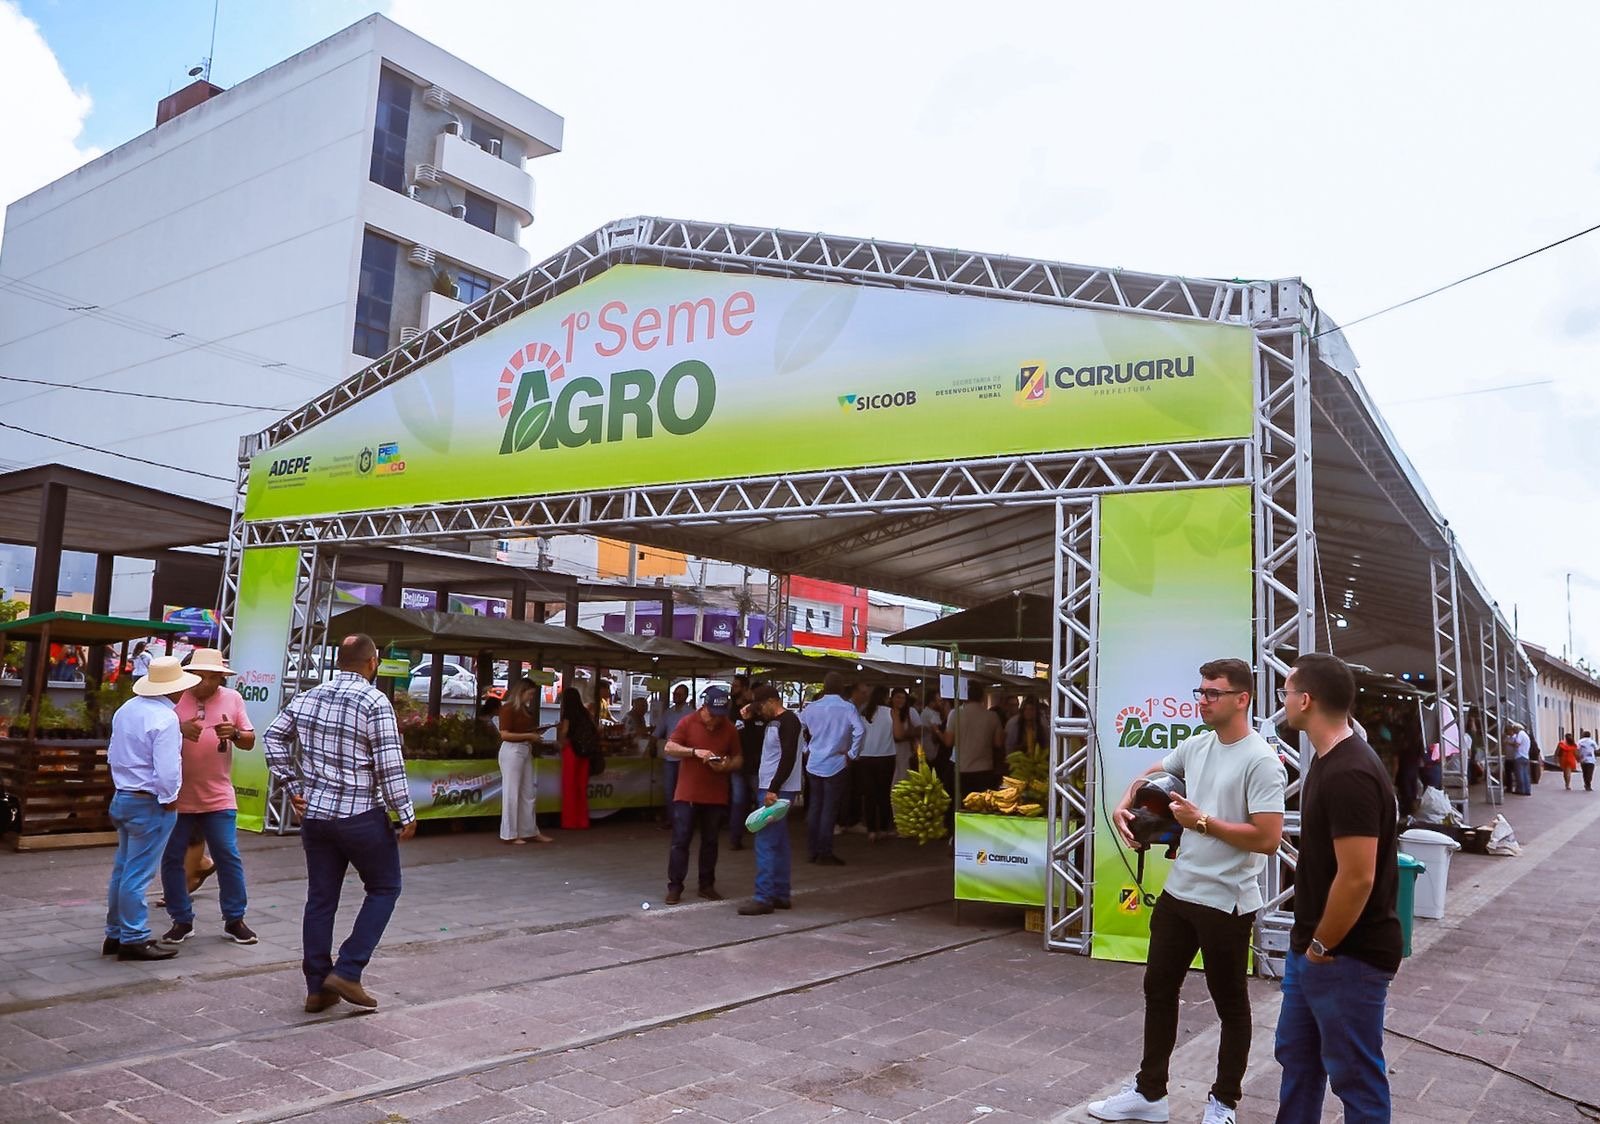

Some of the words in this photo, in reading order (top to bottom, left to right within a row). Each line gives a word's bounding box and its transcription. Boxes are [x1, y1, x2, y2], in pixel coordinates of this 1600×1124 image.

[594, 291, 756, 357] Seme
[936, 383, 1002, 396] DESENVOLVIMENTO
[978, 391, 1002, 399] RURAL
[1094, 386, 1151, 396] PREFEITURA
[499, 360, 717, 455] AGRO
[857, 391, 917, 411] SICOOB
[269, 456, 312, 477] ADEPE
[251, 670, 276, 684] Seme
[586, 783, 614, 799] GRO
